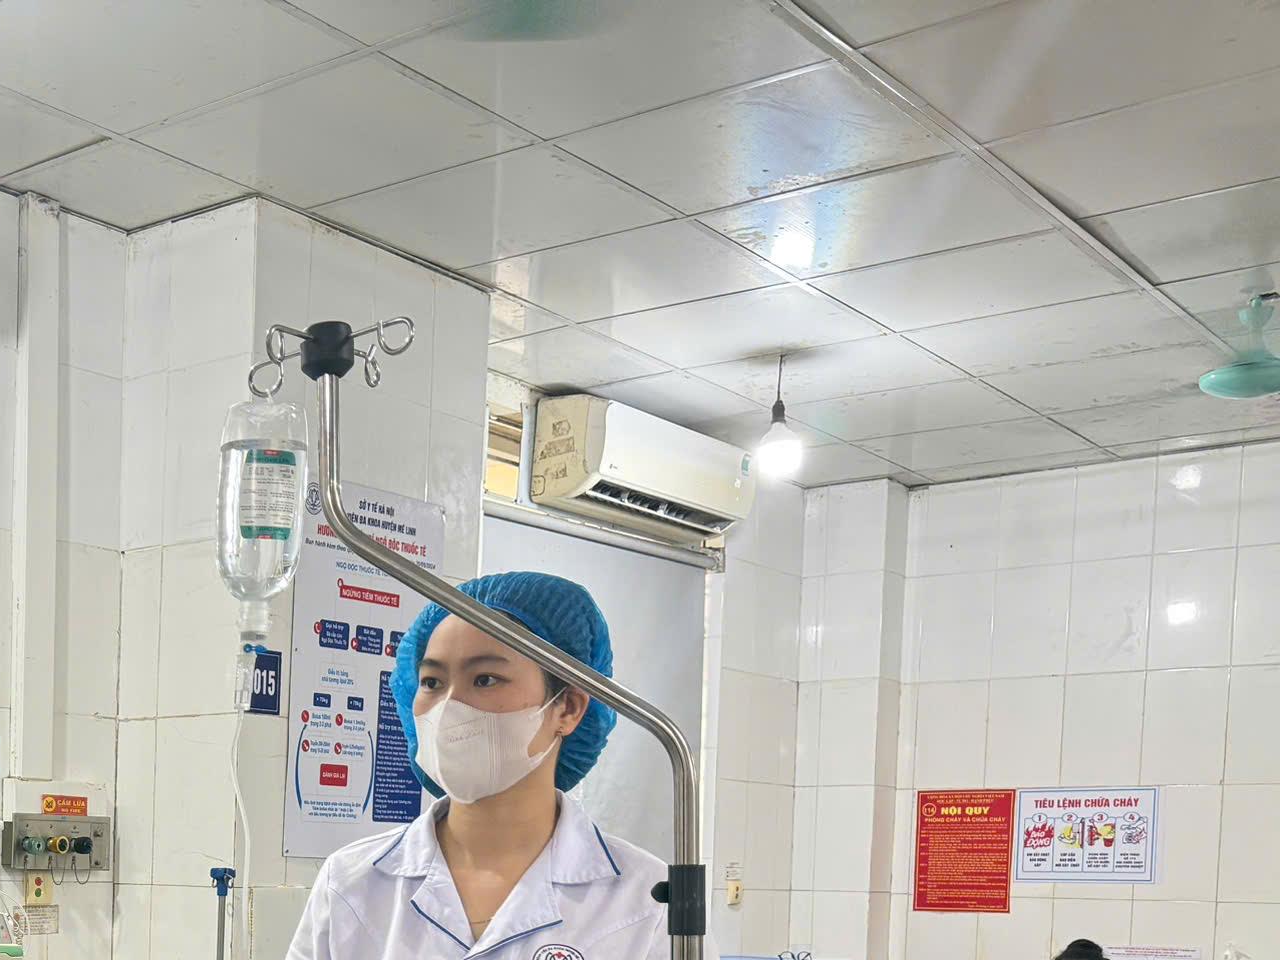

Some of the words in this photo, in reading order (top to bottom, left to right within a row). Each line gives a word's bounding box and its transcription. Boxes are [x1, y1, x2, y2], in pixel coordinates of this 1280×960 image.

[253, 668, 276, 696] 015
[1034, 799, 1055, 809] TIÊU
[1057, 797, 1081, 810] LỆNH
[941, 806, 962, 816] NỘI
[965, 806, 990, 815] QUY
